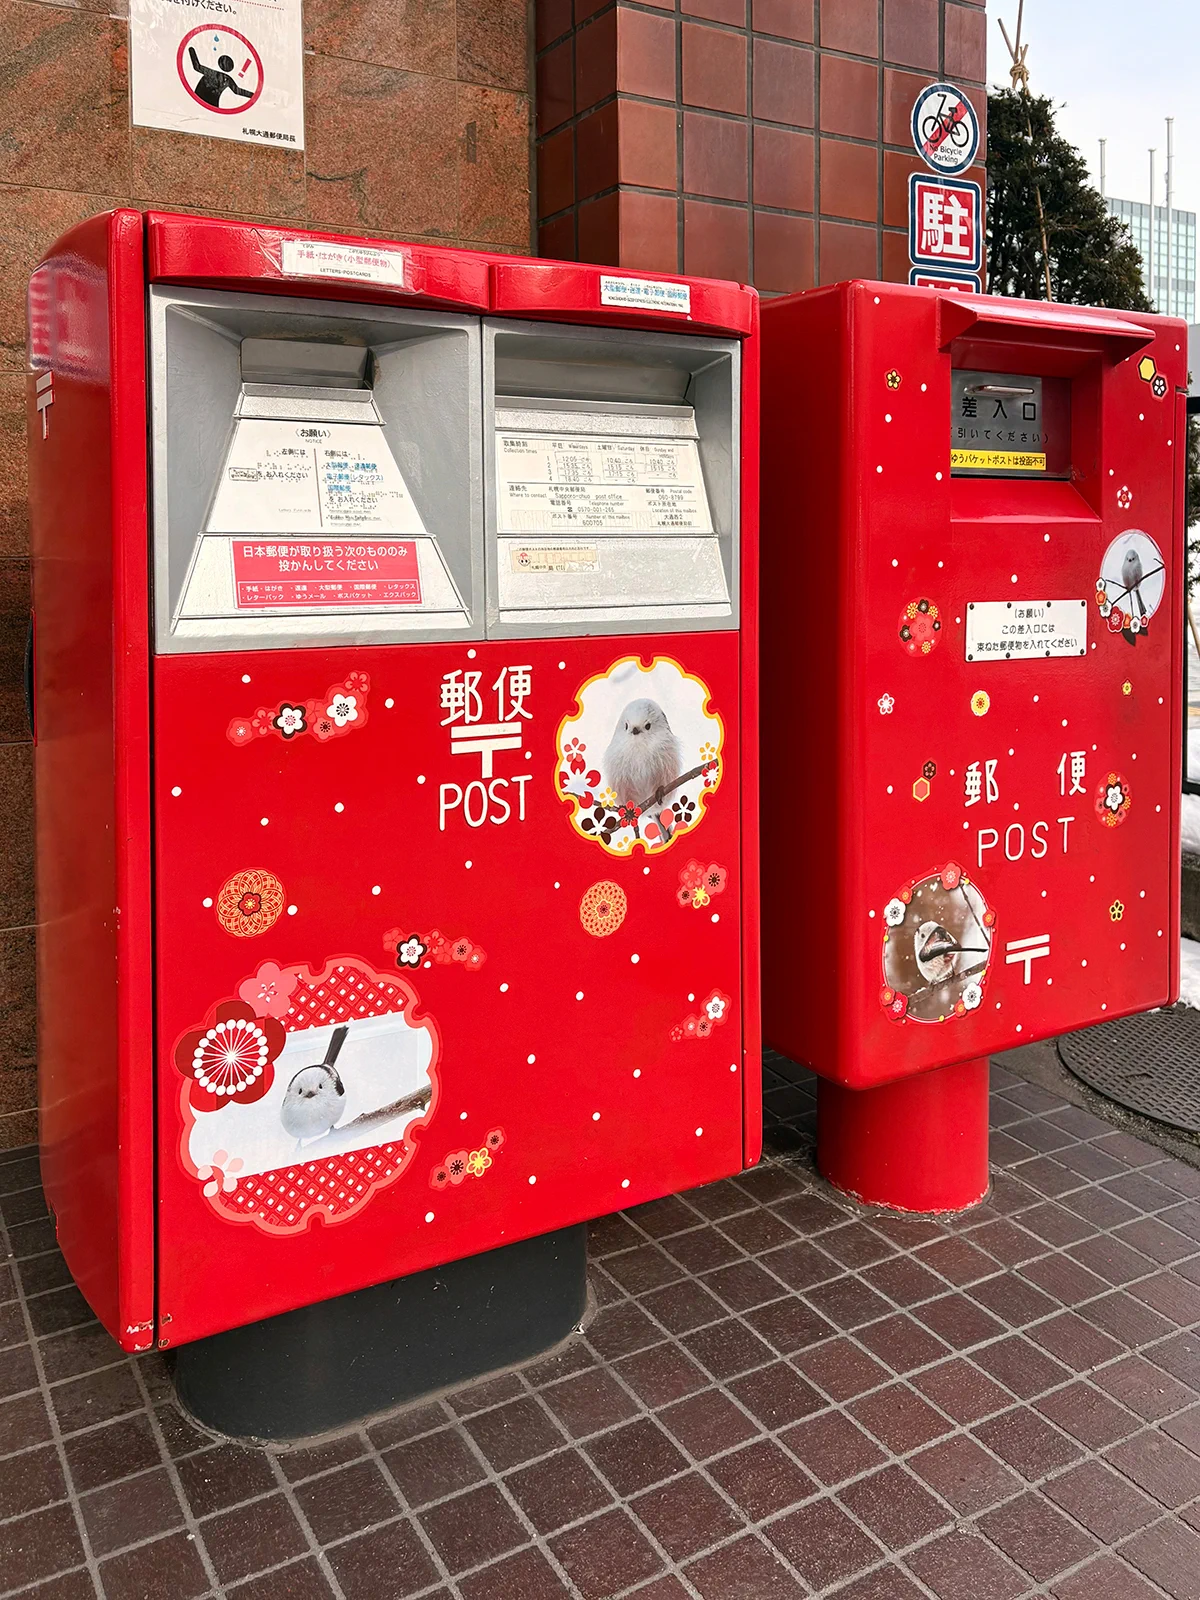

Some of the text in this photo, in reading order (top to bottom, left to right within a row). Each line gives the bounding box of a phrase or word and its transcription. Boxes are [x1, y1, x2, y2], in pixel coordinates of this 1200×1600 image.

[929, 144, 963, 157] No Bicycle
[933, 153, 959, 165] Parking
[920, 192, 970, 257] 駐
[961, 396, 1037, 421] 差入口
[281, 448, 306, 456] 左側には
[337, 496, 378, 504] お入れください
[243, 545, 408, 558] 日本郵便が取り扱う次のもののみ
[278, 559, 379, 572] 投かんしてください
[1001, 624, 1056, 635] この差入口には
[976, 638, 1078, 652] 束ねた郵便物を入れてください
[440, 665, 533, 726] 郵便
[964, 751, 1087, 807] 郵便
[439, 774, 533, 831] POST
[977, 816, 1075, 868] POST
